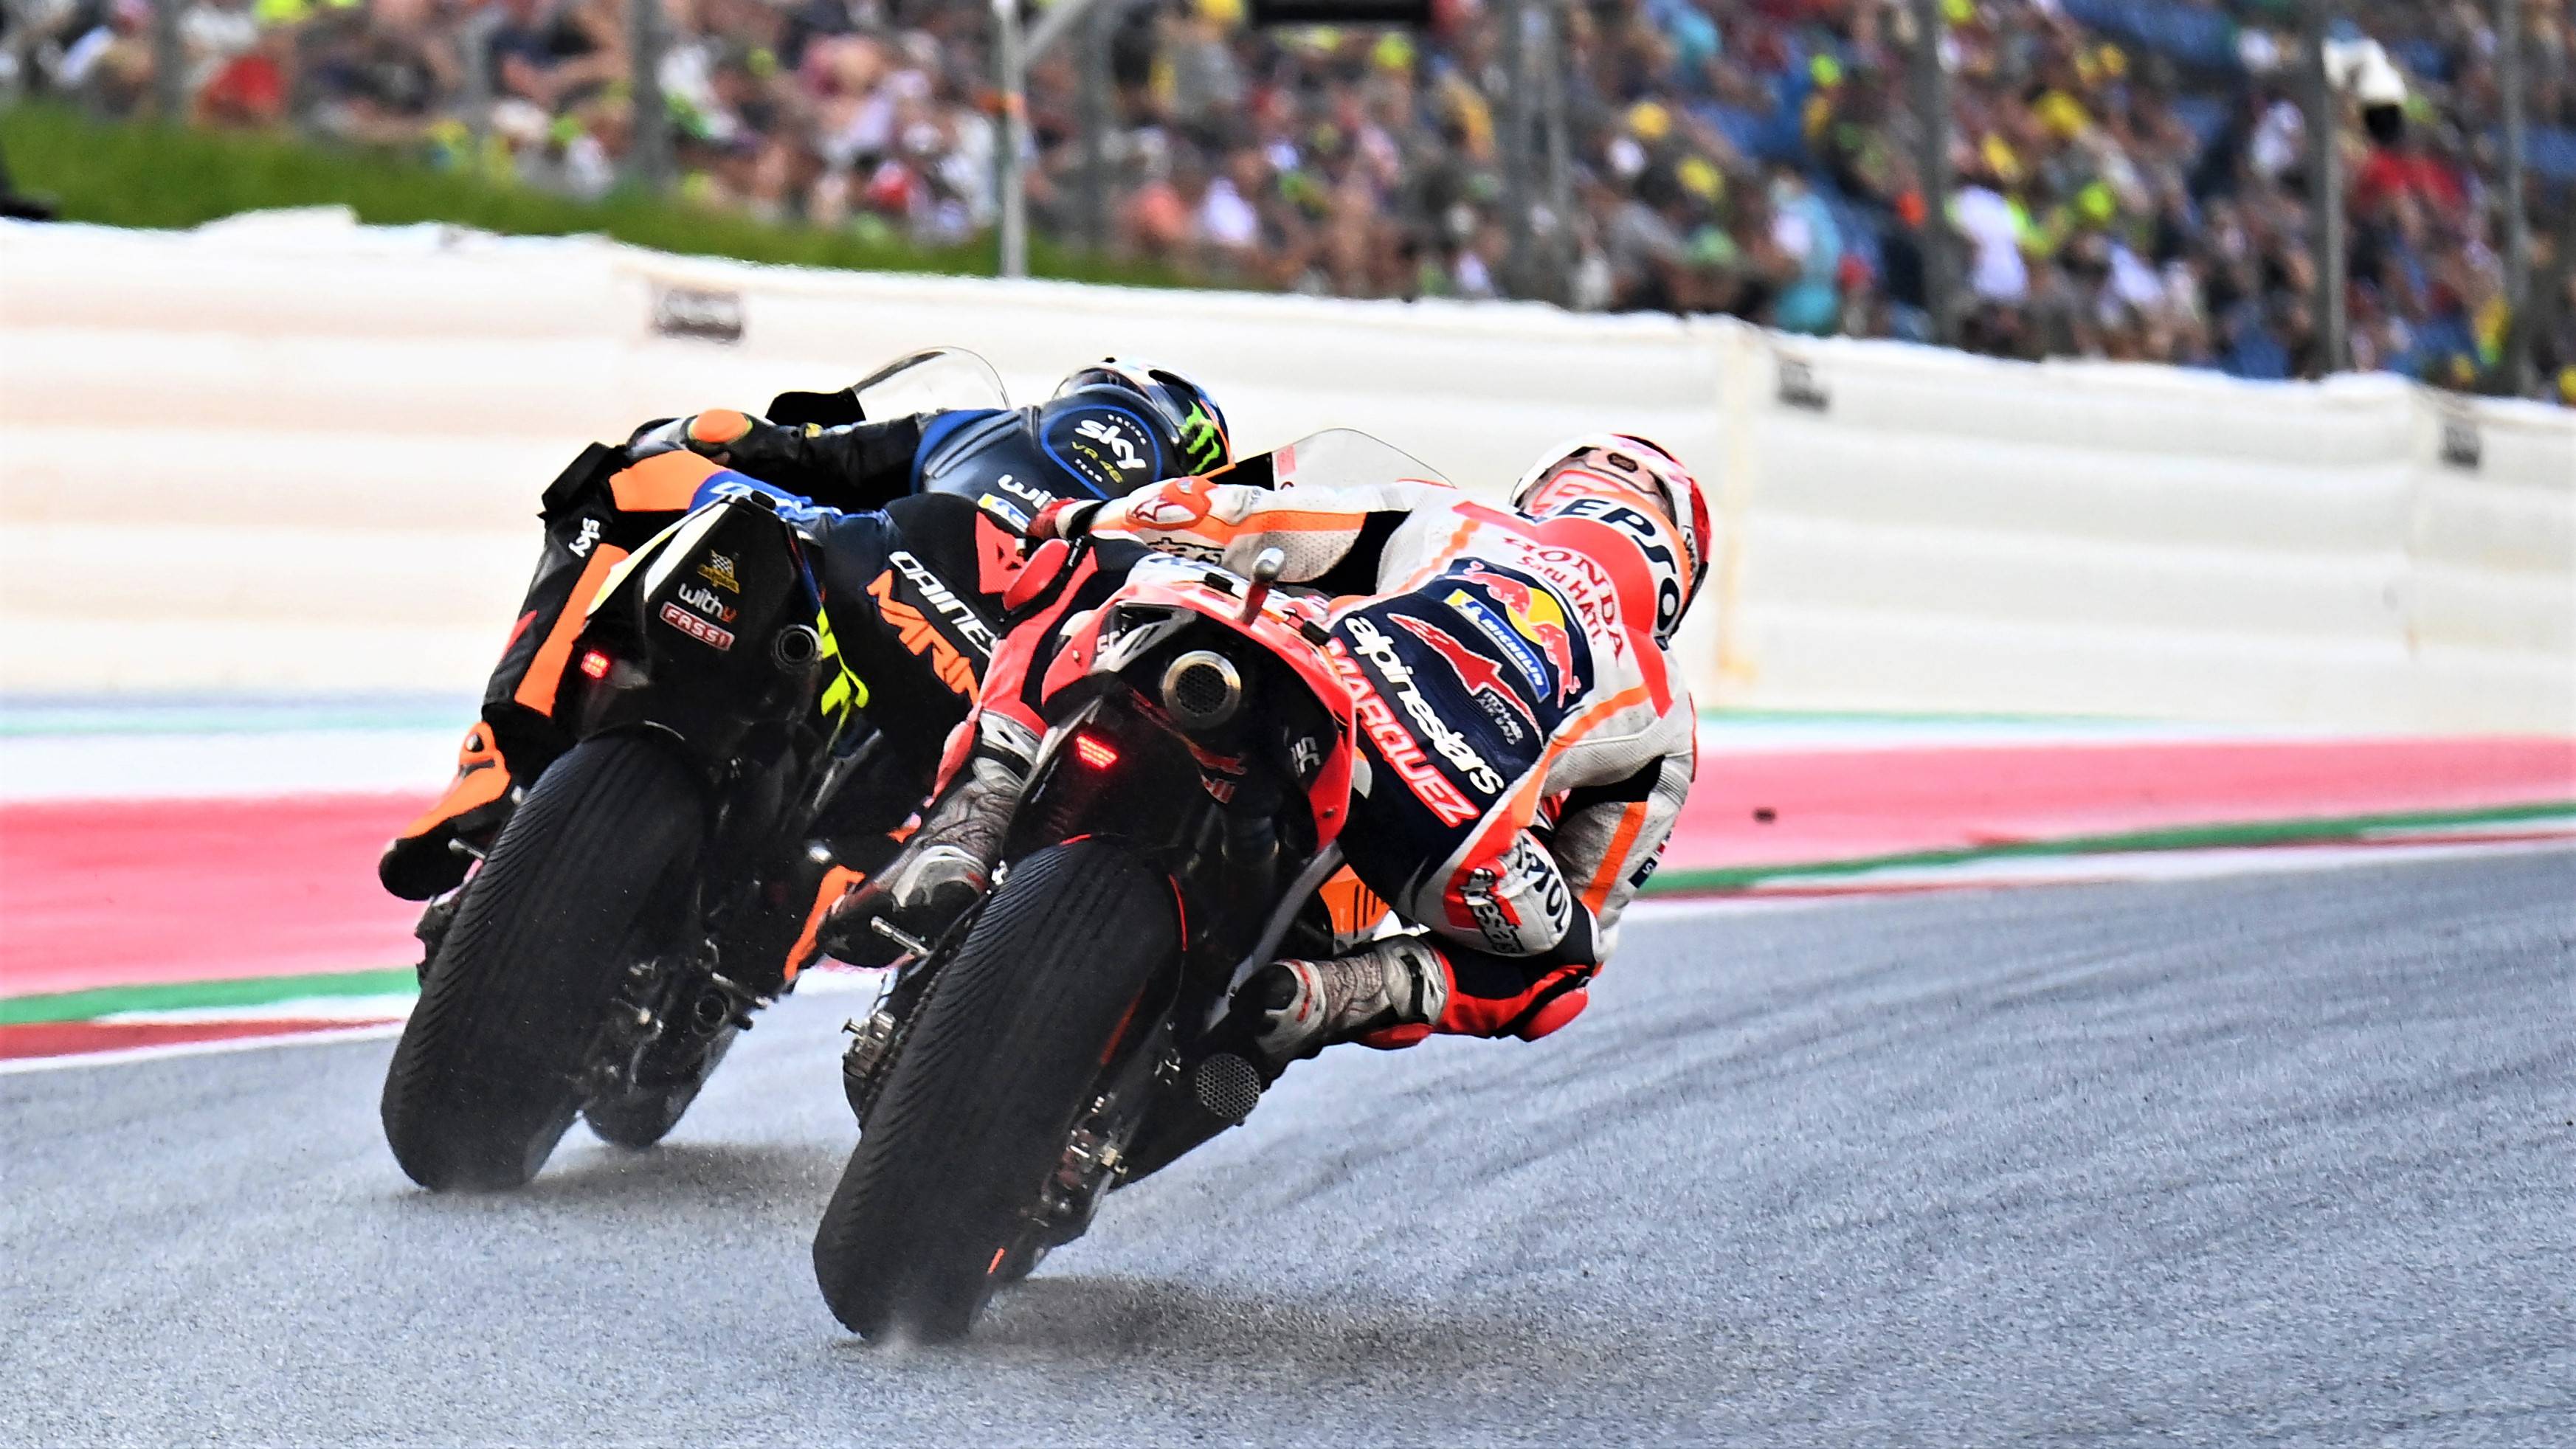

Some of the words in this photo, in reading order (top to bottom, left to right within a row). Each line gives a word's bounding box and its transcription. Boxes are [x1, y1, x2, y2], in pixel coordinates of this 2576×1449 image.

[666, 608, 731, 649] FASSI
[1502, 536, 1623, 666] HONDA
[1516, 499, 1679, 632] EPSO
[866, 569, 981, 706] MARIN
[1481, 622, 1545, 686] MICHELIN
[1345, 616, 1505, 795] alpinestars
